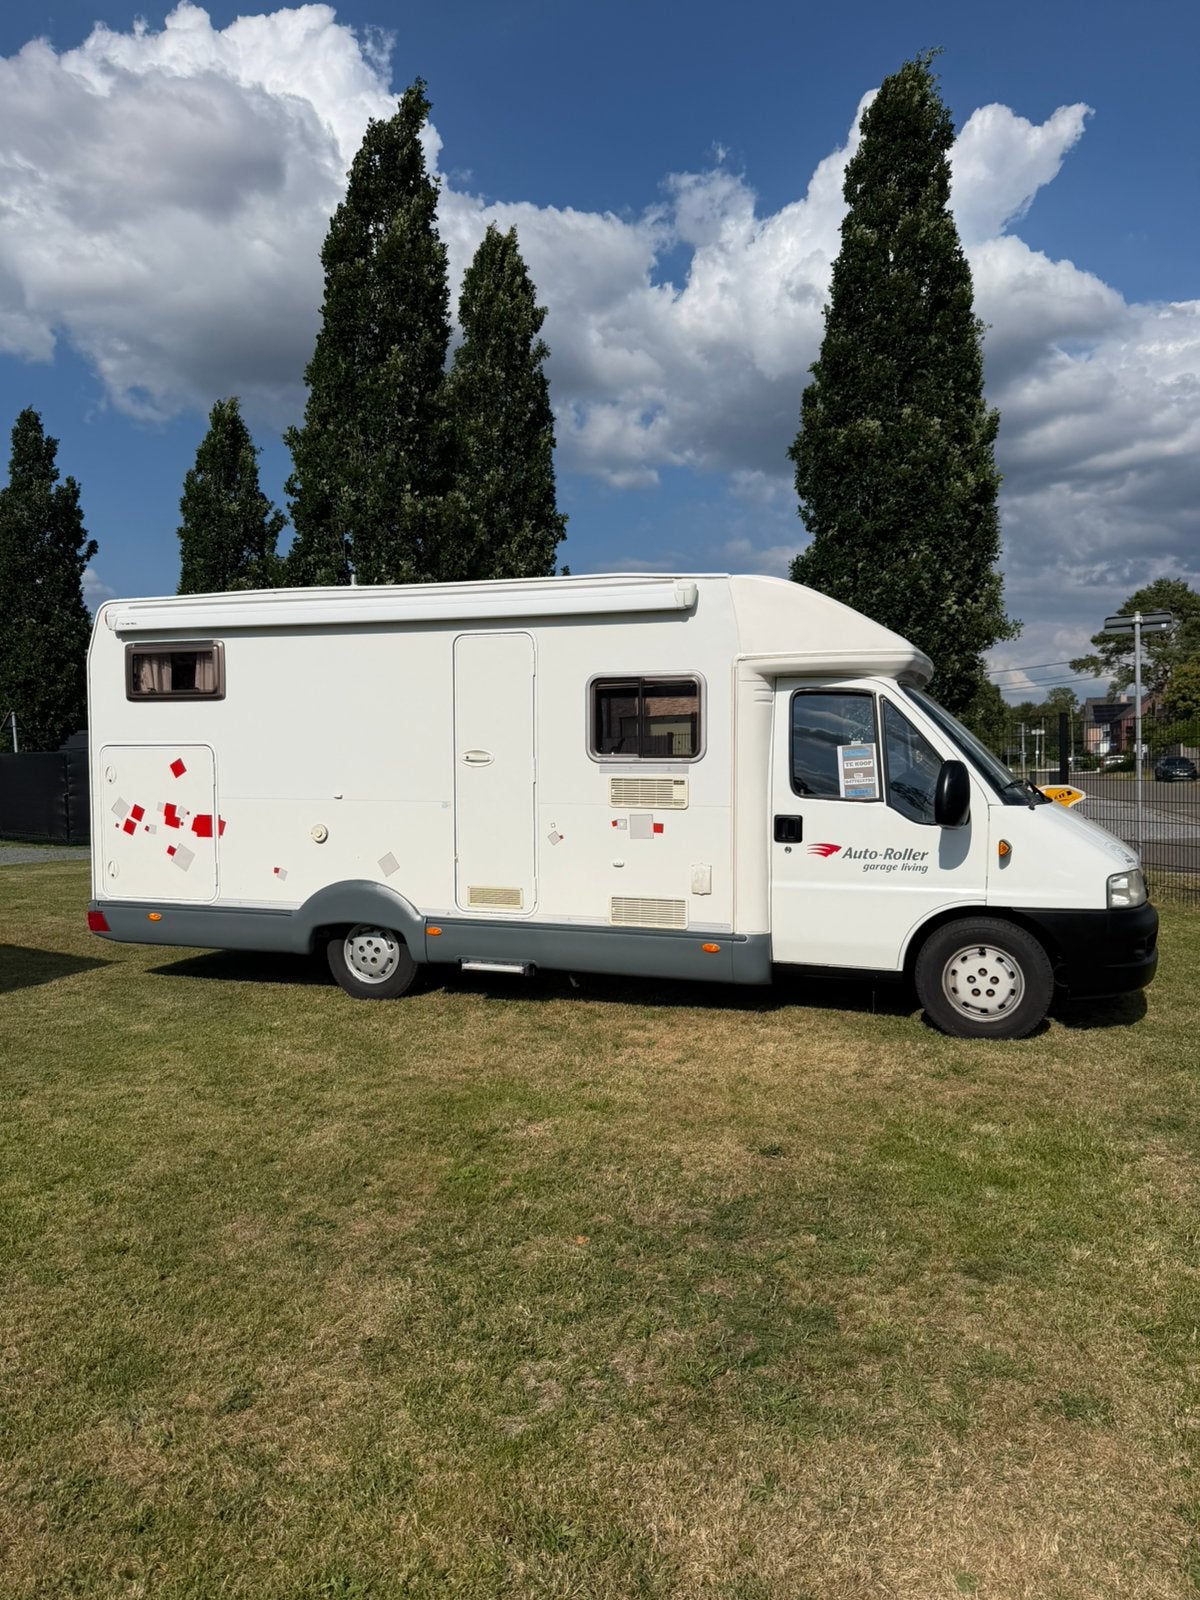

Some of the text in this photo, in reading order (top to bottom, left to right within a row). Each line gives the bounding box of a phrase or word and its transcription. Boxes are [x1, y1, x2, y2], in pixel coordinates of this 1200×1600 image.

[842, 847, 929, 861] Auto-Roller
[862, 862, 929, 874] garage living
